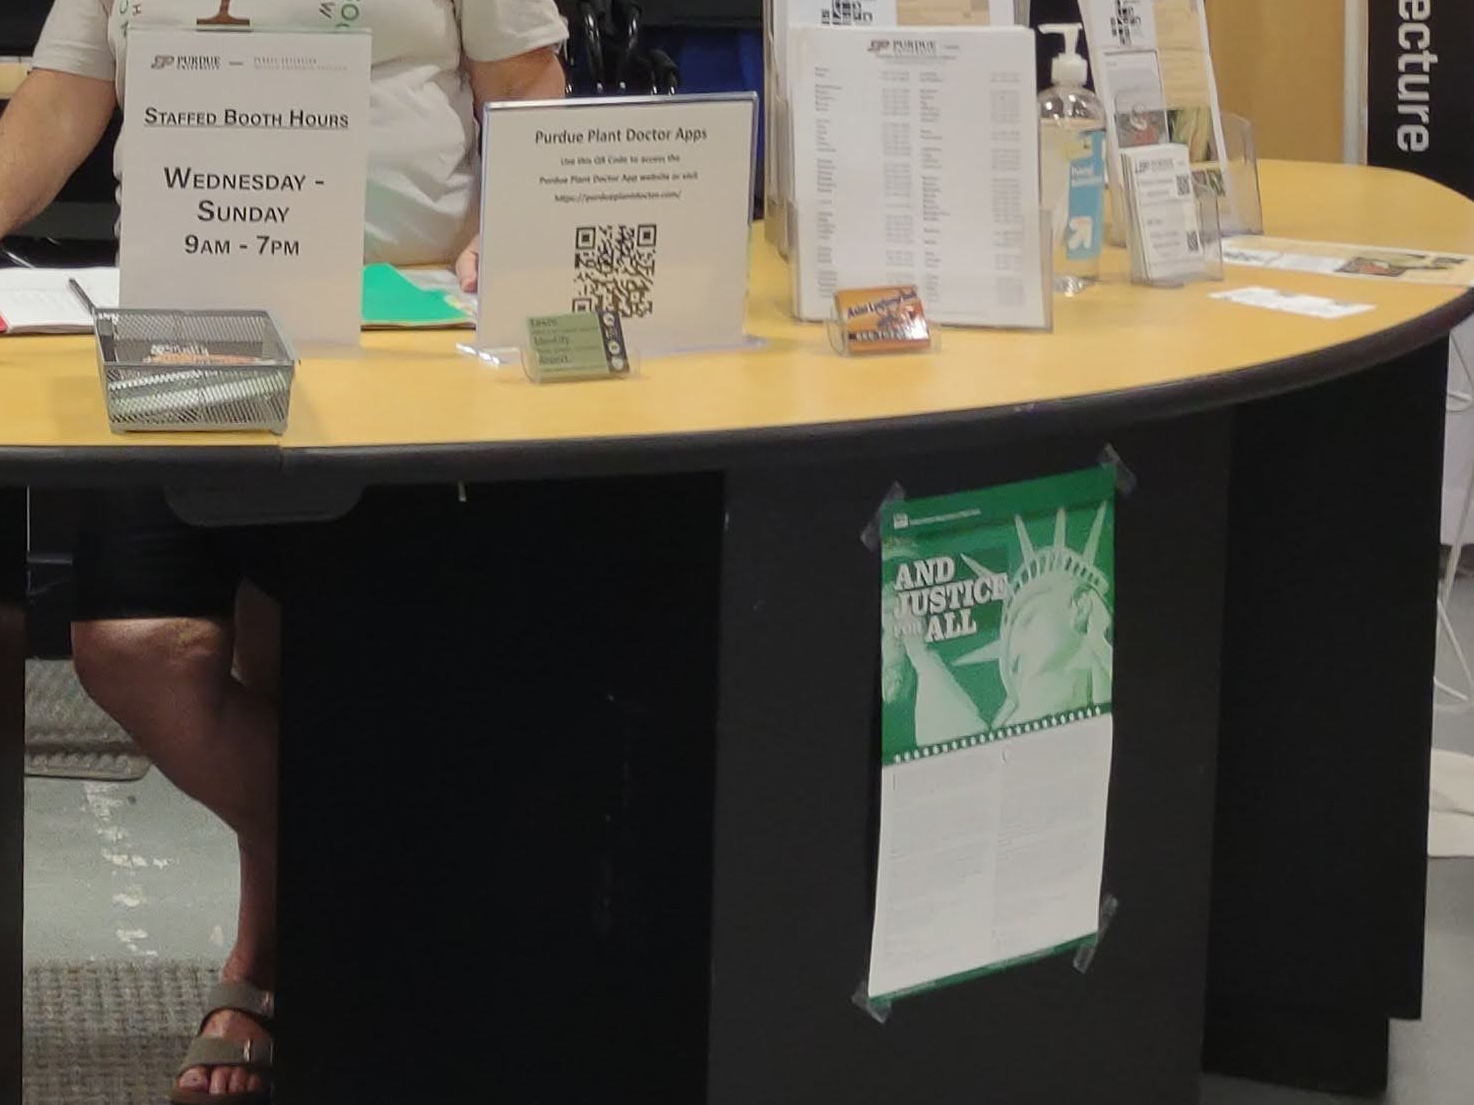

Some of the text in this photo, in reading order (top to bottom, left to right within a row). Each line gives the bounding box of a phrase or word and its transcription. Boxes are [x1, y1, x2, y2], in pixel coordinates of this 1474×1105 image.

[177, 55, 220, 66] PURDUE
[145, 107, 348, 128] STAFFED BOOTH HOURS
[535, 127, 708, 144] Purdue Plant Doctor Apps
[561, 157, 575, 166] Use
[577, 157, 592, 166] this
[608, 156, 628, 165] Code
[630, 156, 639, 164] to
[640, 156, 665, 164] access
[667, 154, 681, 163] the
[164, 167, 306, 191] WEDNESDAY
[539, 176, 568, 185] Purdue
[570, 175, 591, 184] Plant
[593, 175, 619, 184] Doctor
[622, 175, 638, 184] App
[639, 172, 670, 182] website
[197, 200, 290, 223] SUNDAY
[184, 235, 230, 256] 9AM
[256, 236, 300, 256] 7PM
[894, 556, 955, 591] AND
[894, 572, 1008, 619] JUSTICE
[925, 609, 977, 644] ALL
